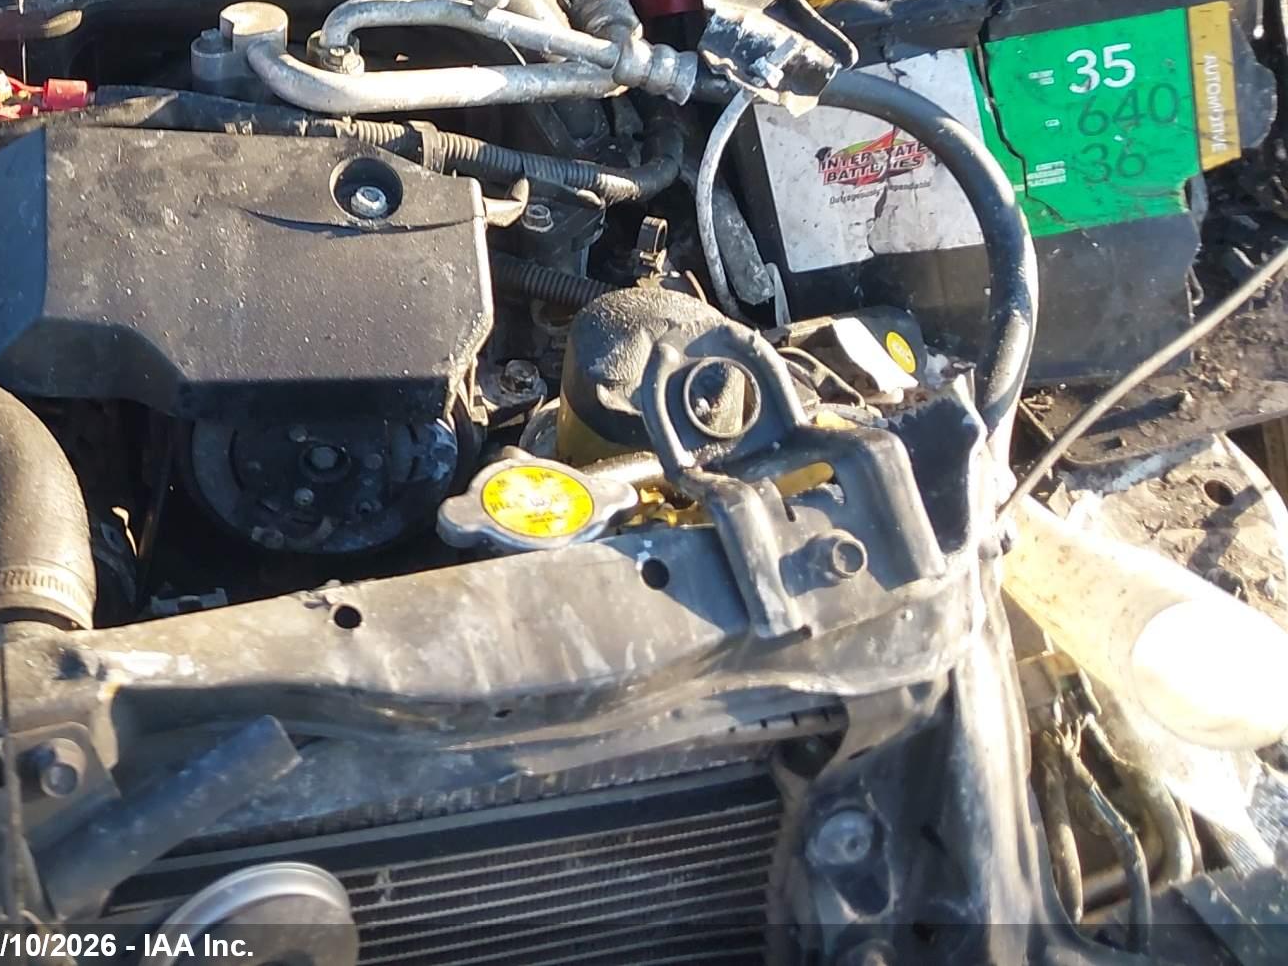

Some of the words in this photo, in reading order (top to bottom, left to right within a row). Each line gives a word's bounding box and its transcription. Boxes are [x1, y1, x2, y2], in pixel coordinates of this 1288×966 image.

[1067, 43, 1136, 94] 35
[1078, 82, 1180, 137] 640
[1203, 54, 1228, 153] AUTOMOTIVE
[1081, 142, 1148, 185] 36
